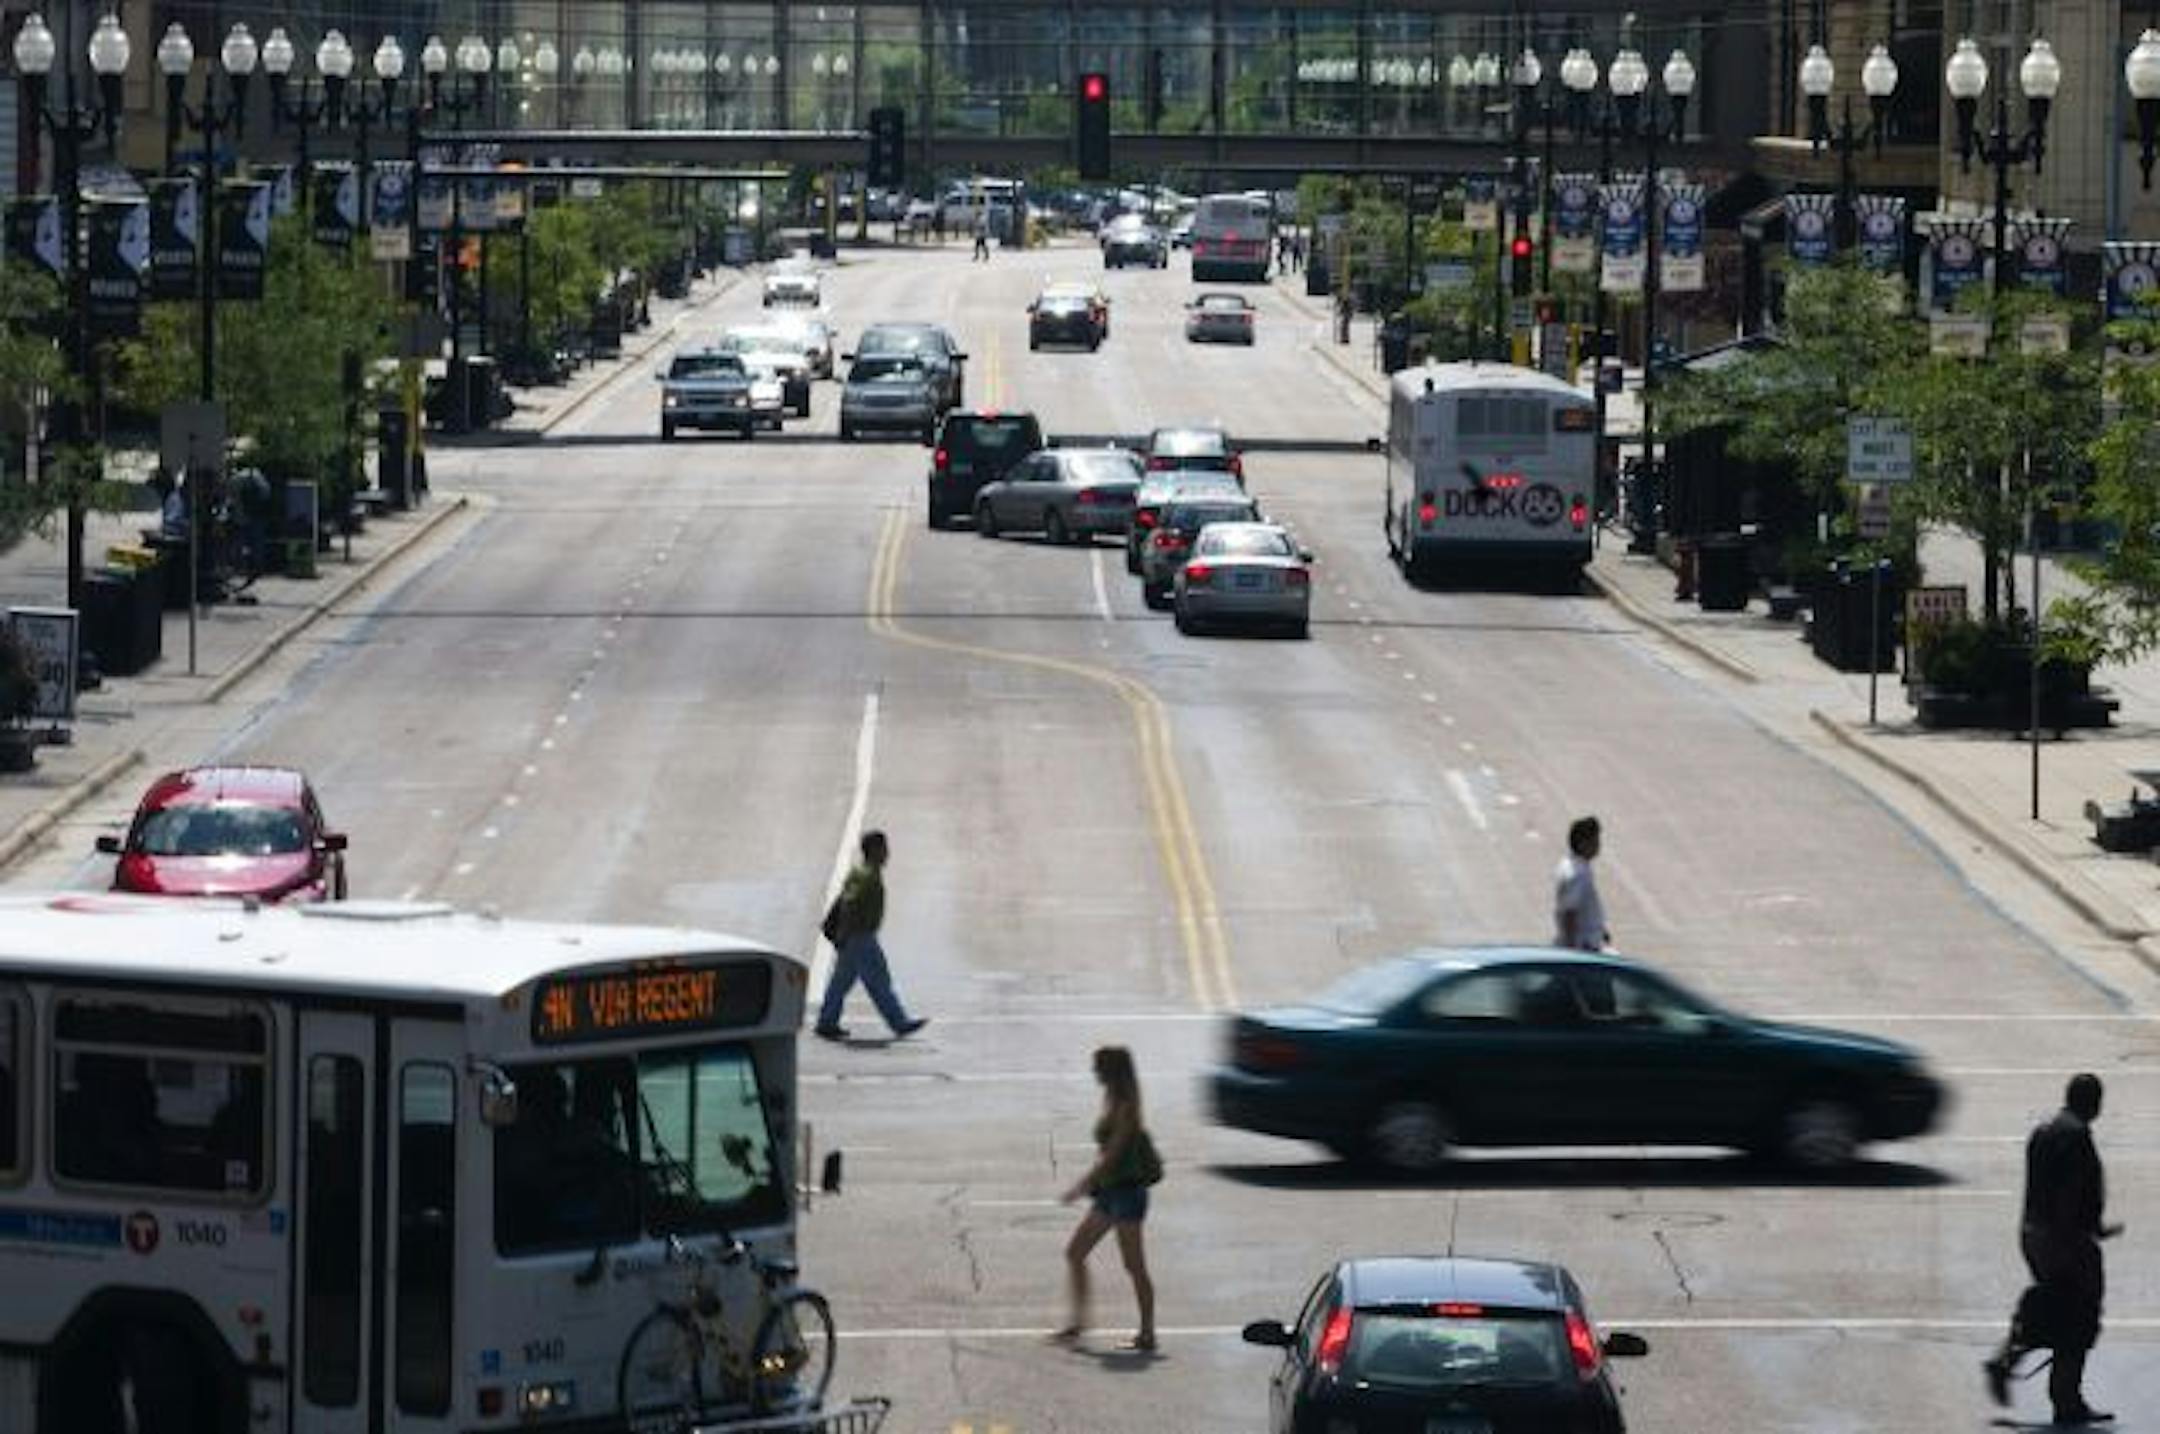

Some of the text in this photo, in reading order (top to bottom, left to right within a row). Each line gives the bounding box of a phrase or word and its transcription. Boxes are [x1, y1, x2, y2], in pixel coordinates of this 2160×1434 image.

[1444, 488, 1518, 518] DOCK
[588, 977, 630, 1029] VIA
[635, 970, 718, 1022] REGENT
[175, 1219, 227, 1247] 1040
